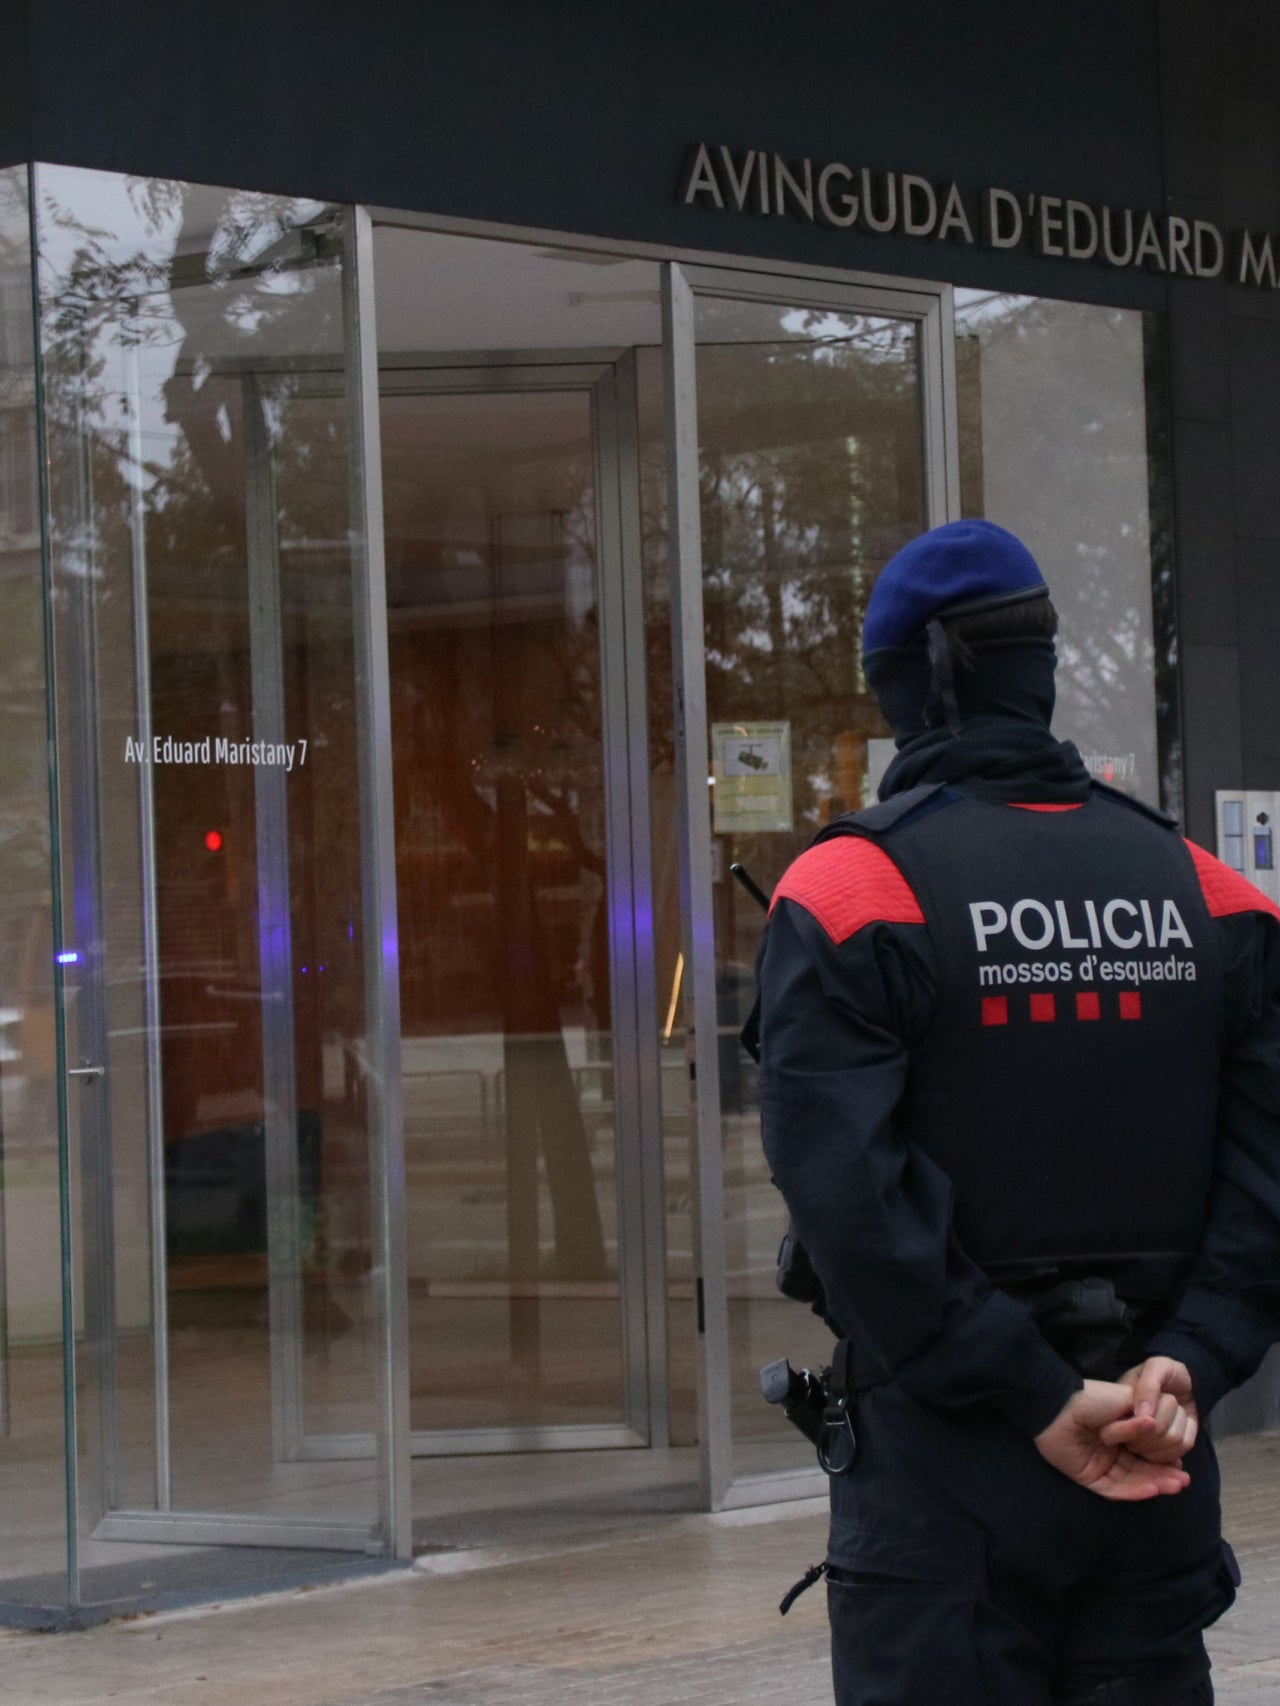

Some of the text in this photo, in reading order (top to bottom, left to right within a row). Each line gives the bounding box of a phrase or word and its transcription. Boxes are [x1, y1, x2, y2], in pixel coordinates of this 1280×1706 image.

[685, 142, 973, 244] AVINGUDA
[989, 187, 1225, 278] D'EDUARD
[124, 735, 307, 772] Av. Eduard Maristany 7
[969, 898, 1194, 952] POLICIA
[978, 954, 1197, 986] mossos d'esquadra
